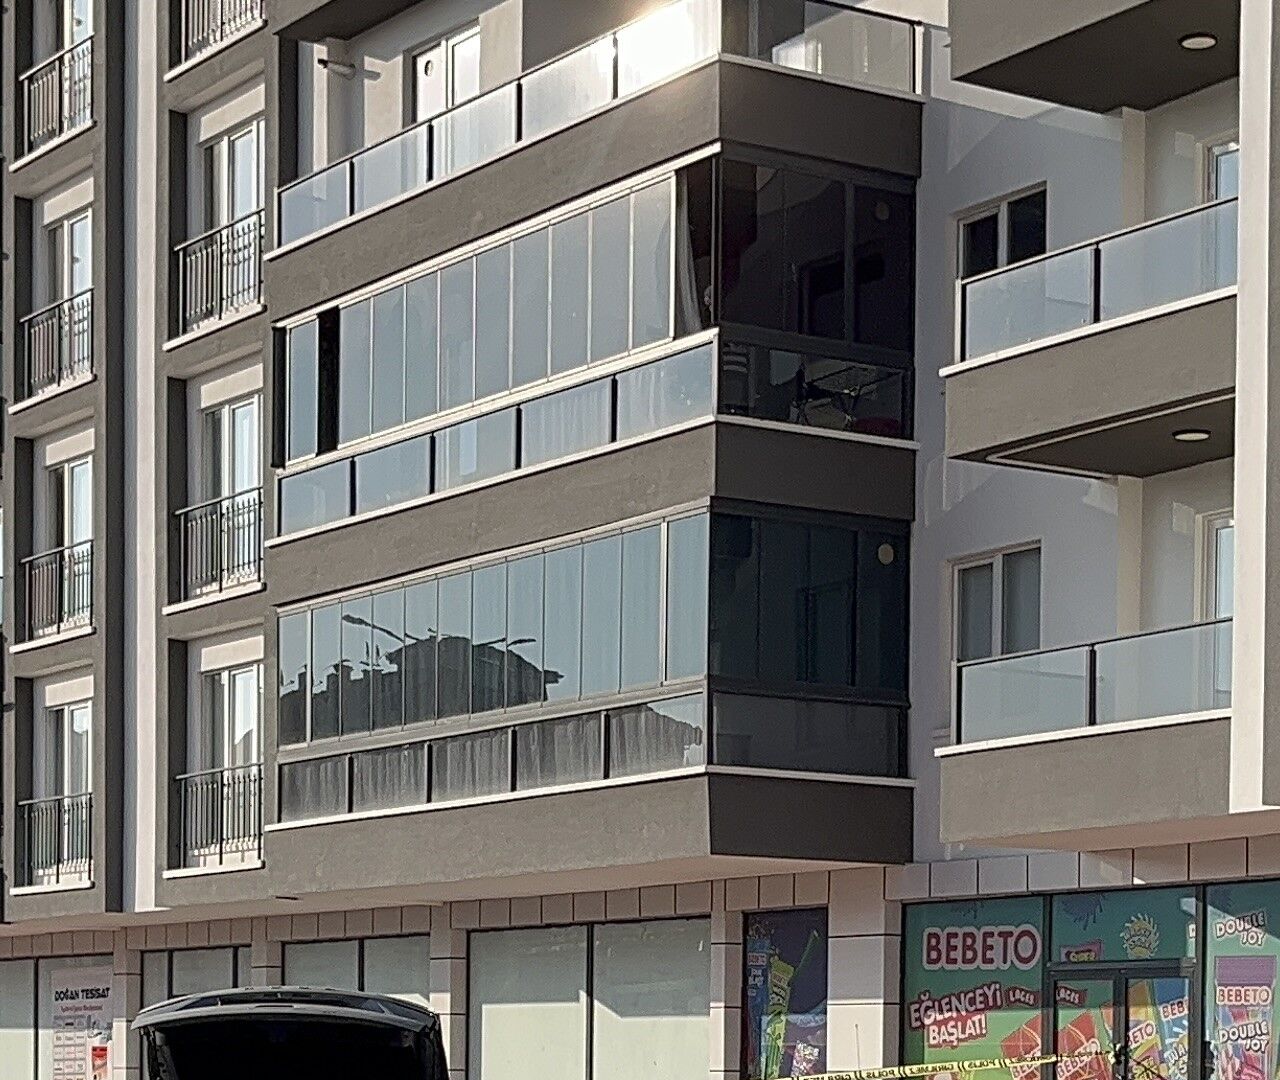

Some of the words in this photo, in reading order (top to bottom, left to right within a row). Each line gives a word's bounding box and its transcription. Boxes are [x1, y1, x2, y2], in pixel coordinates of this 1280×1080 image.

[1216, 911, 1265, 937] DOUBLE
[926, 929, 1038, 965] BEBETO
[1241, 931, 1264, 945] JOY
[1218, 988, 1270, 1003] BEBETO
[929, 1013, 987, 1046] BAŞLAT!
[1218, 1020, 1268, 1043] DOUBLE
[1245, 1039, 1269, 1053] JOY
